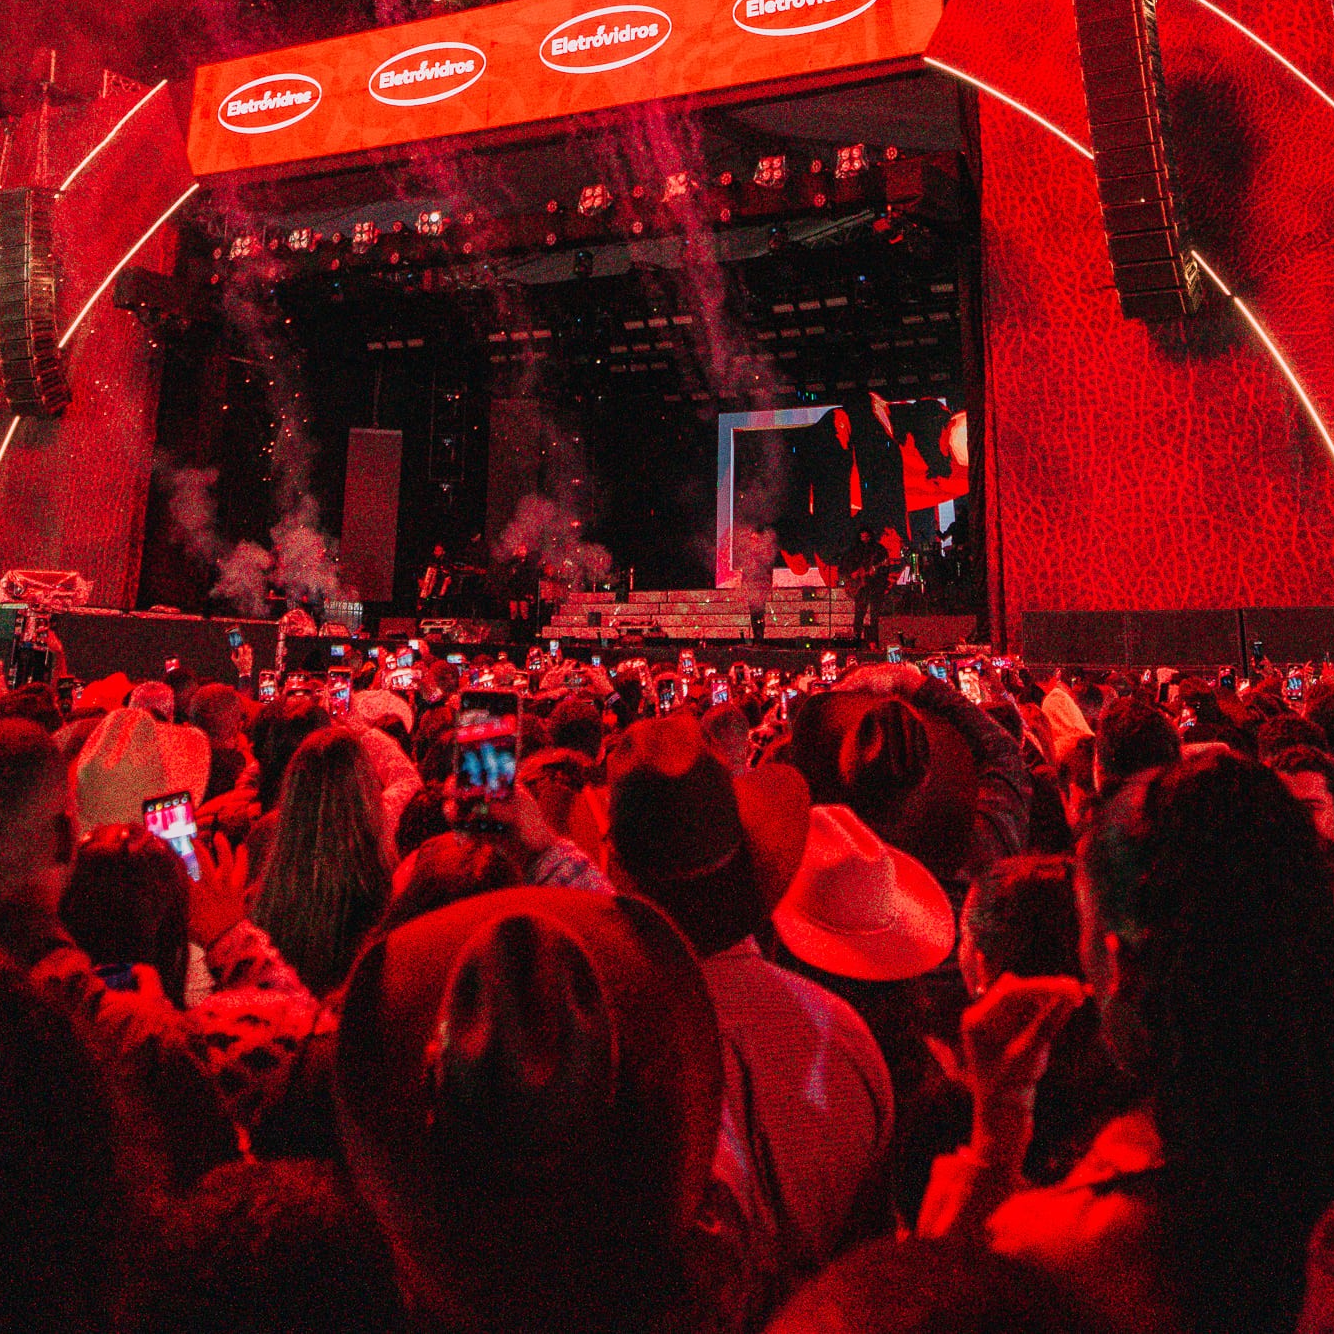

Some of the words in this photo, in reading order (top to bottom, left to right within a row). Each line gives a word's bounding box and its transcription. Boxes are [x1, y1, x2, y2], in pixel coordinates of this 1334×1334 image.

[551, 20, 659, 57] Eletróvidros
[378, 57, 475, 90] Eletróvidros
[226, 89, 312, 118] Eletróvidros
